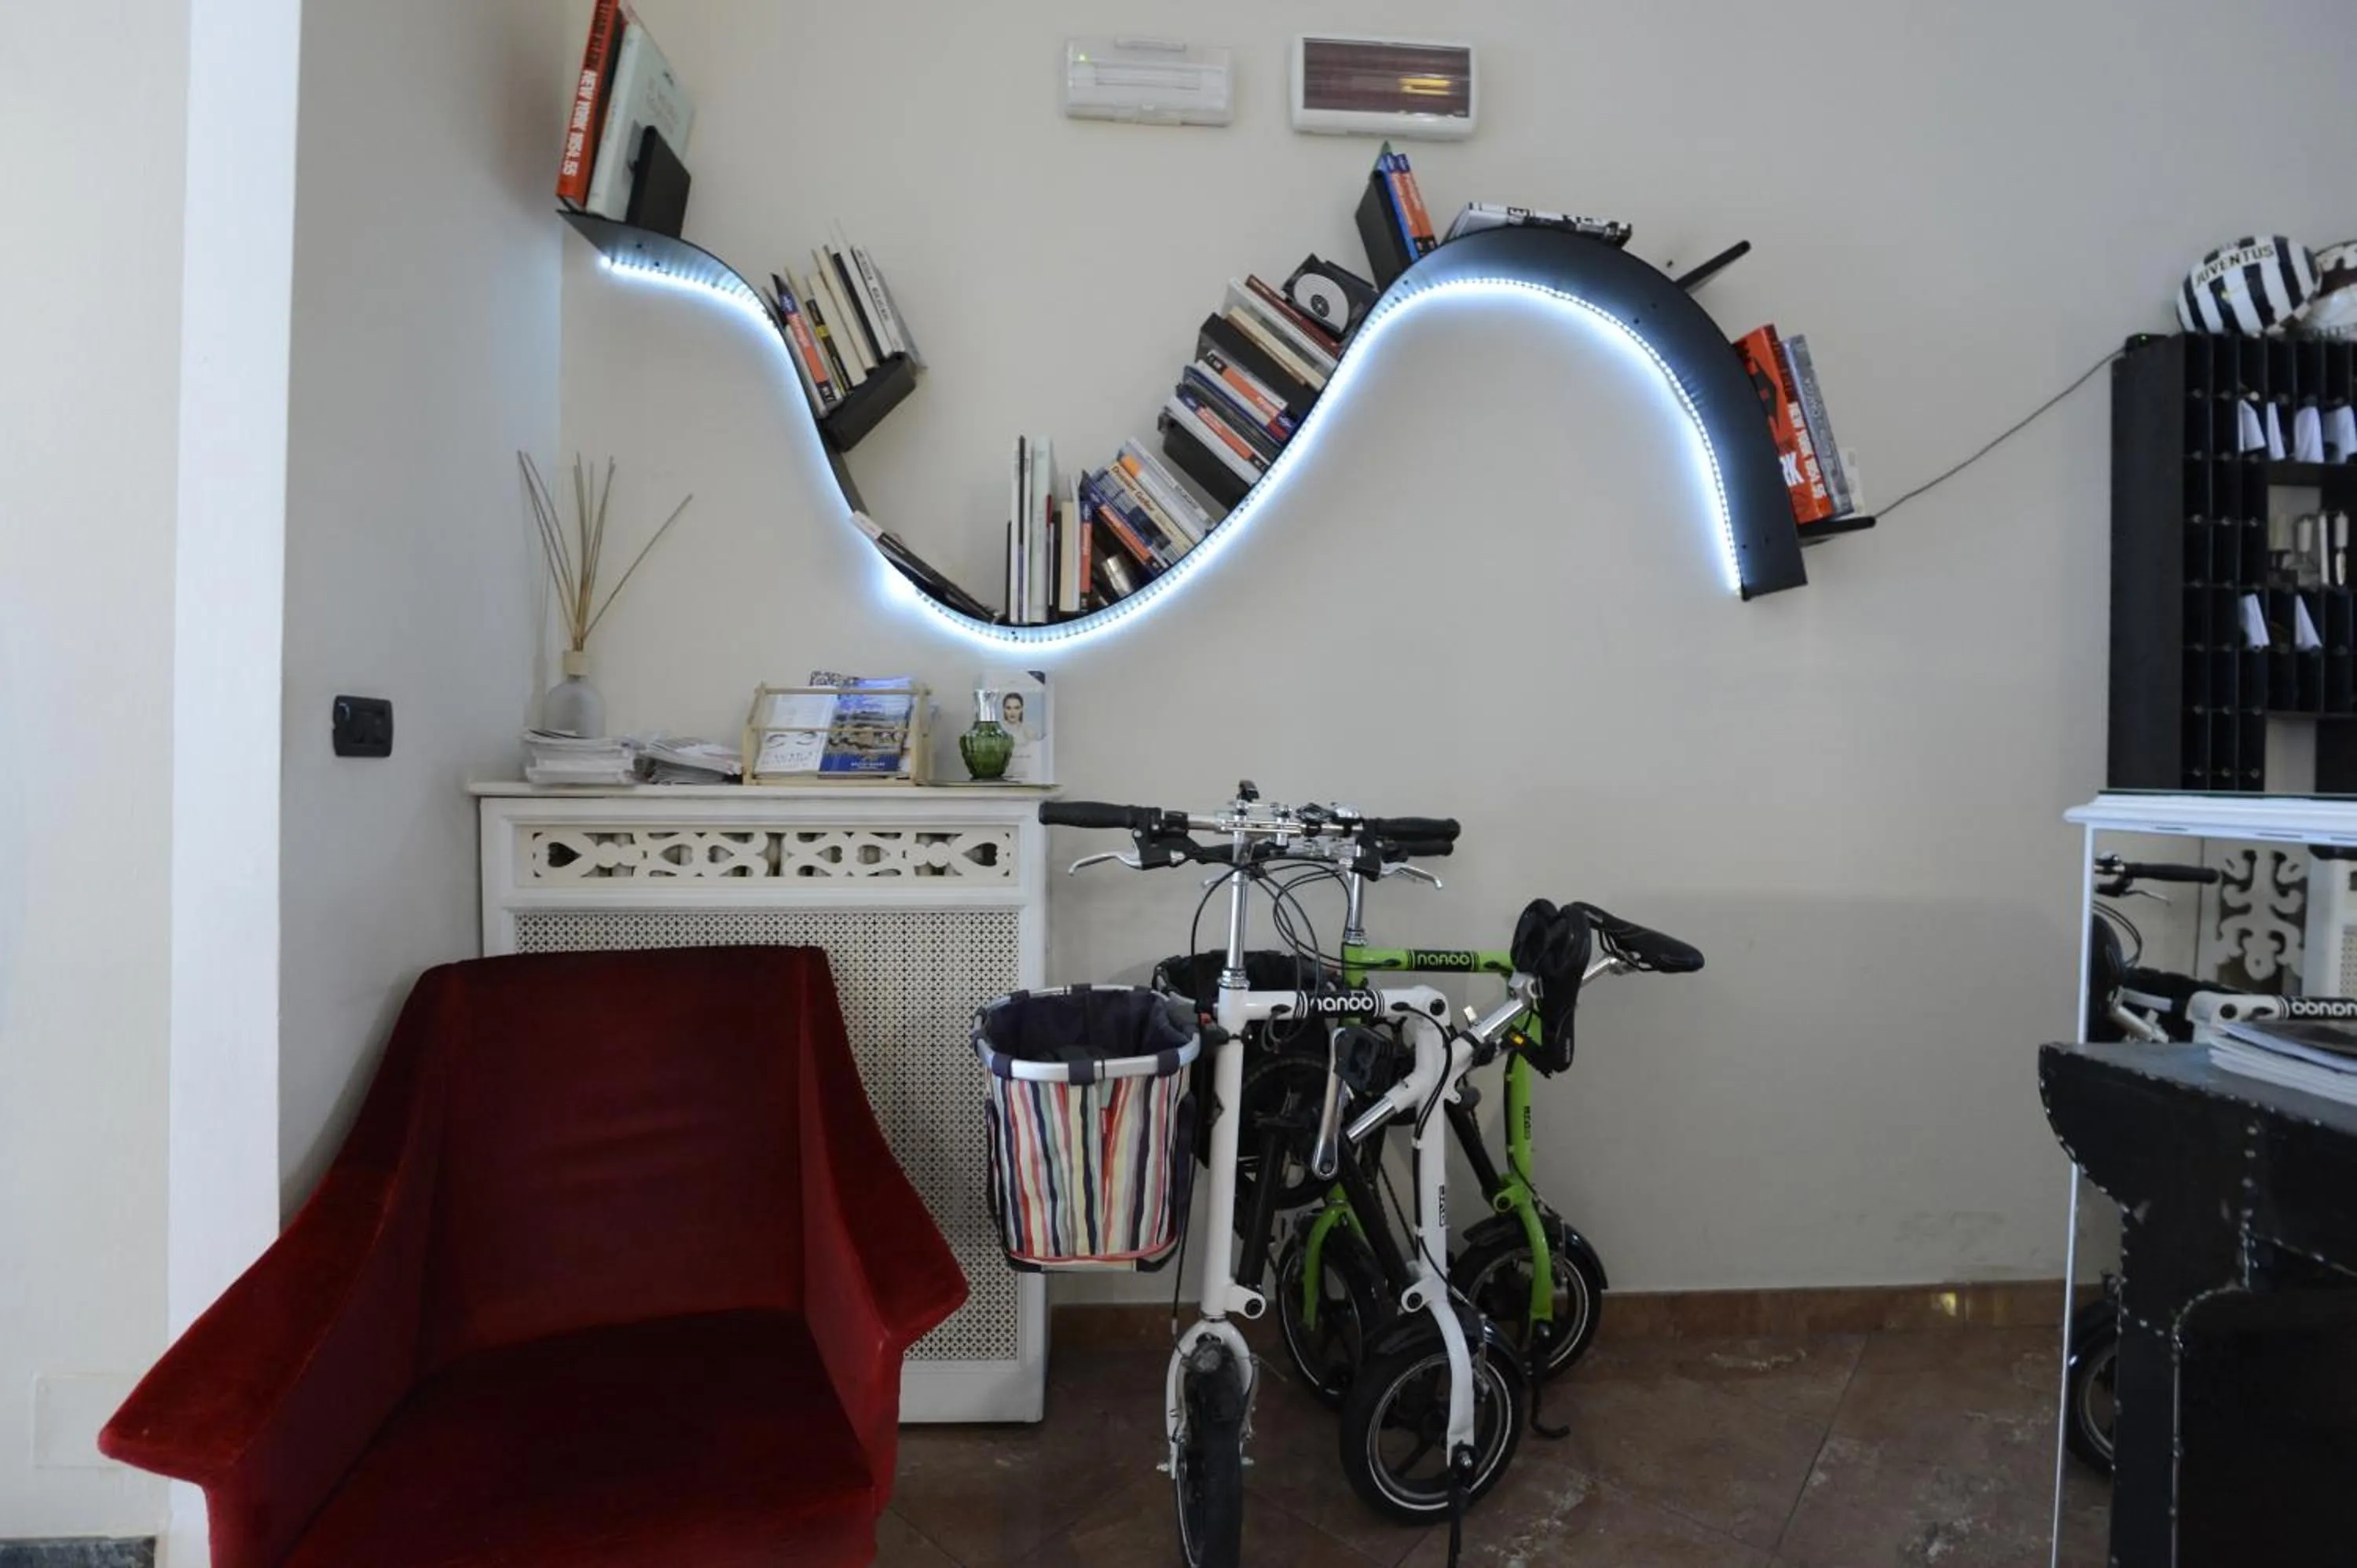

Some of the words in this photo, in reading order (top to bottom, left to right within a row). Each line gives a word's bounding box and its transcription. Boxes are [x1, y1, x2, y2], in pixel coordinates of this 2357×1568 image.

[2195, 244, 2274, 287] JUVENTUS
[1417, 952, 1471, 966] nanoo
[1310, 995, 1374, 1012] nanoo
